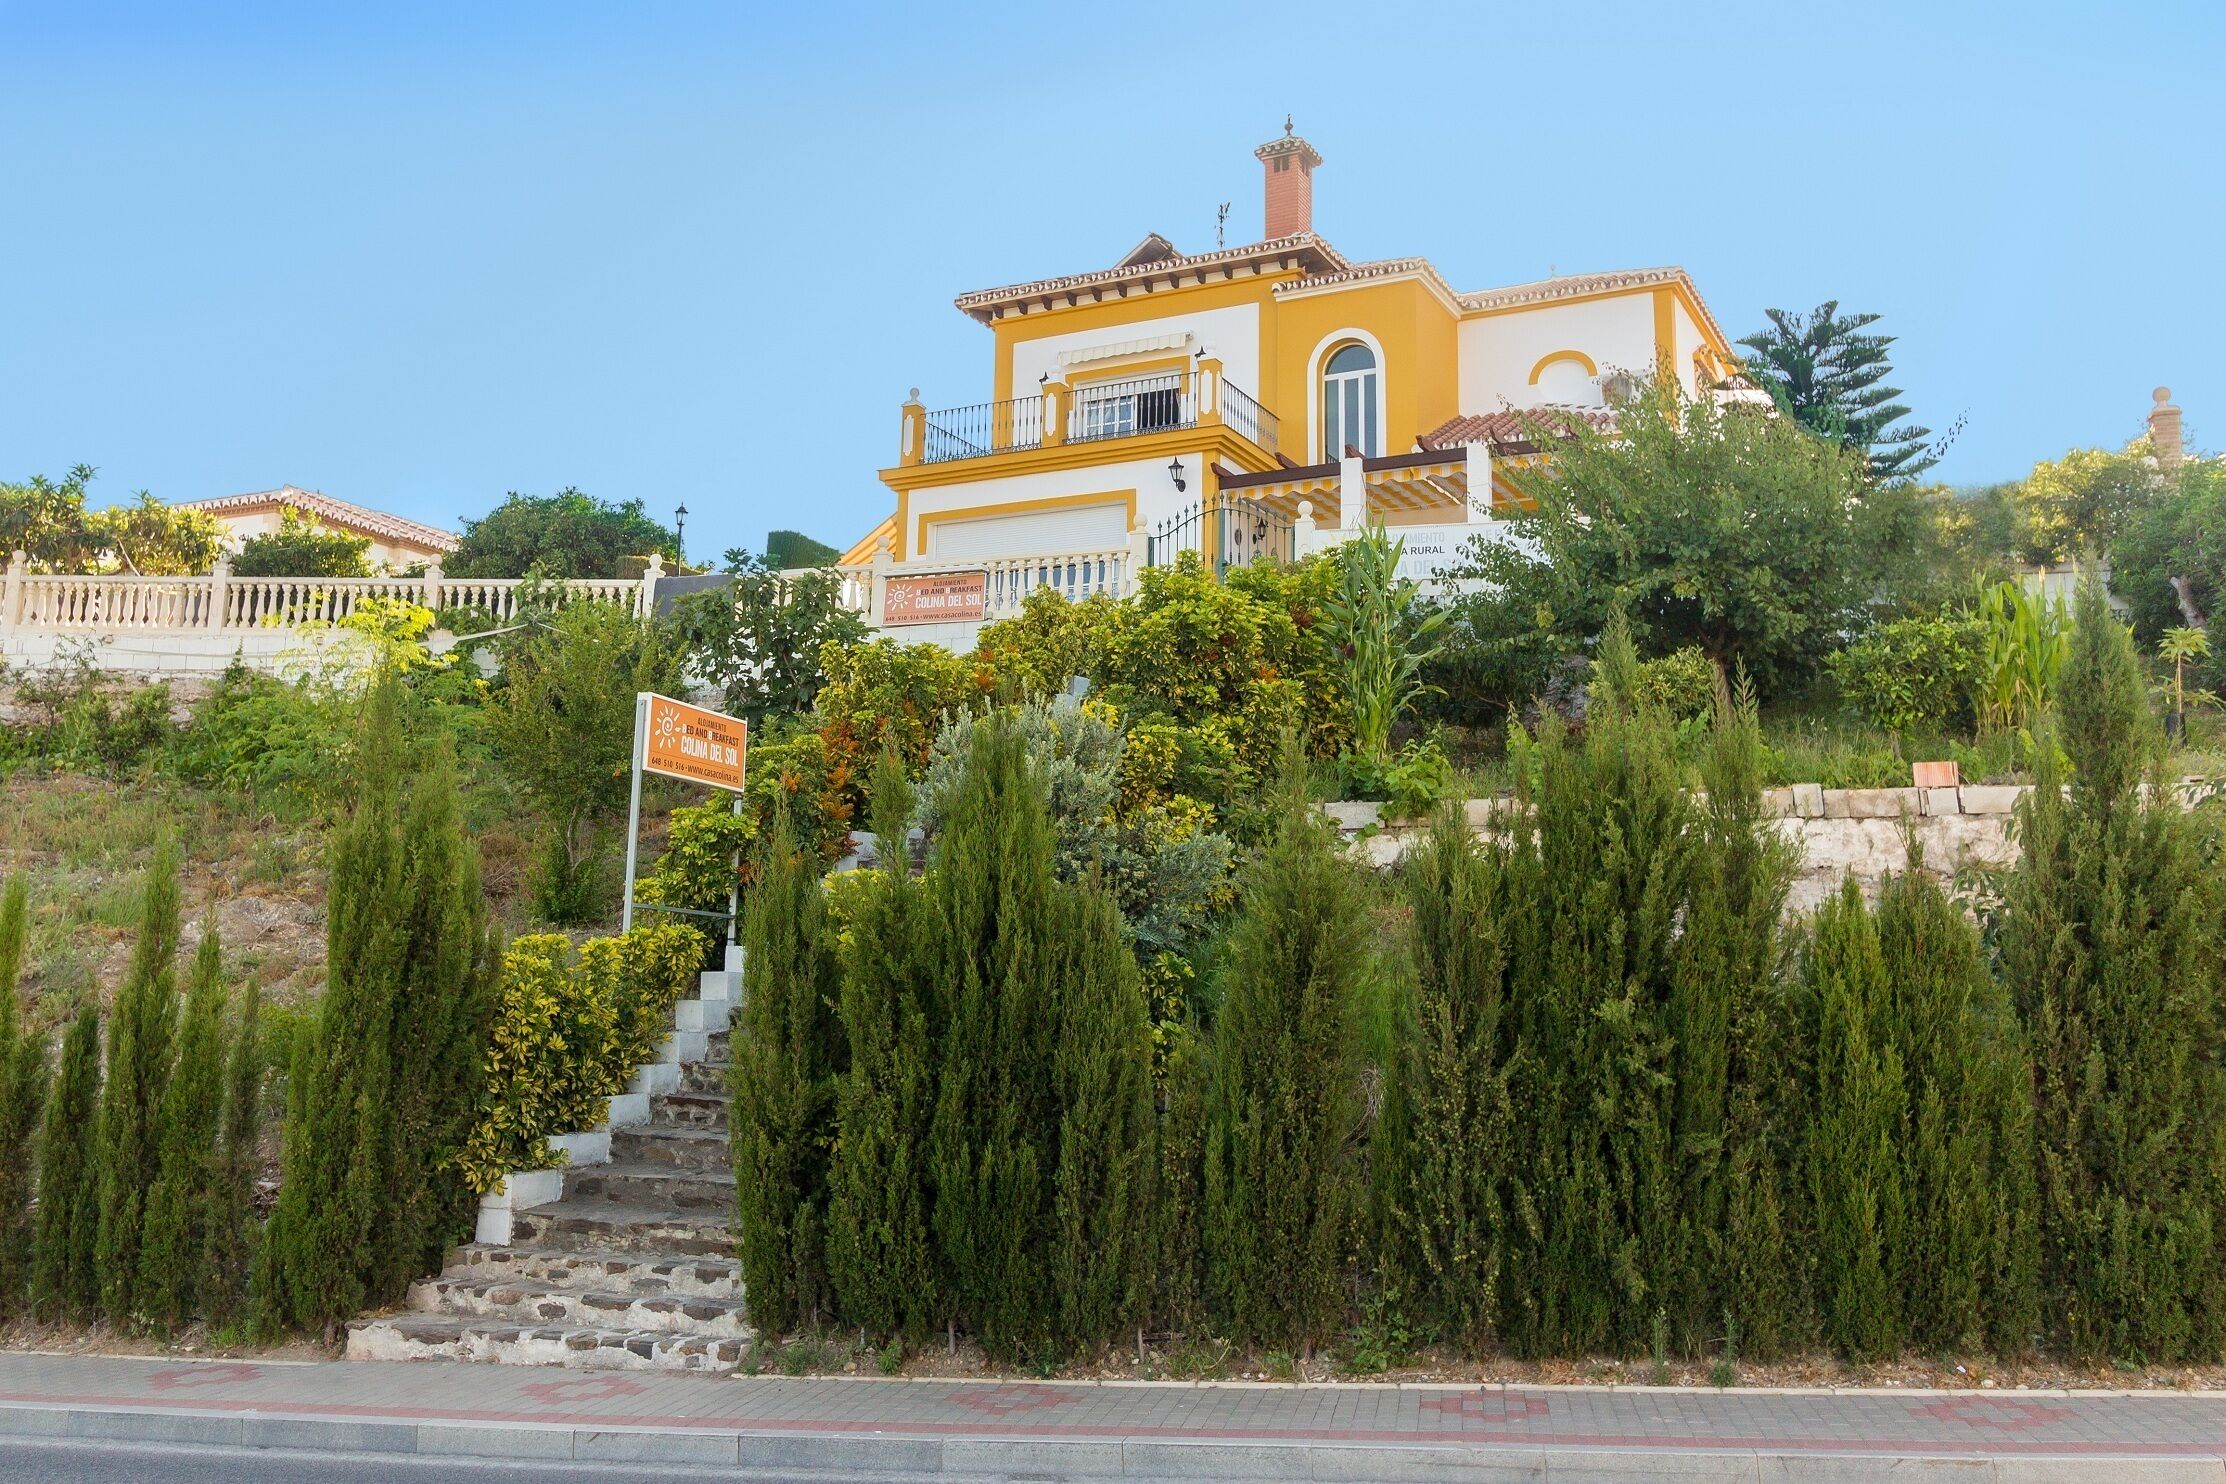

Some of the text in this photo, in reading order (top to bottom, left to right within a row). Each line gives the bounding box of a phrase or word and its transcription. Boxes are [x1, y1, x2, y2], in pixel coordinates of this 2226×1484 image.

[1411, 545, 1446, 556] RURAL
[933, 579, 967, 587] ALOJAMIENTO
[916, 585, 982, 596] BED AND BREAKFAST
[915, 593, 982, 609] COLINA DEL SOL
[698, 717, 727, 732] ALOJAMIENTO
[682, 723, 739, 747] BED AND BREAKFAST
[681, 735, 739, 767] COLINA DEL SOL
[651, 757, 661, 765] 648
[663, 759, 673, 768] 510
[675, 761, 685, 771] 516
